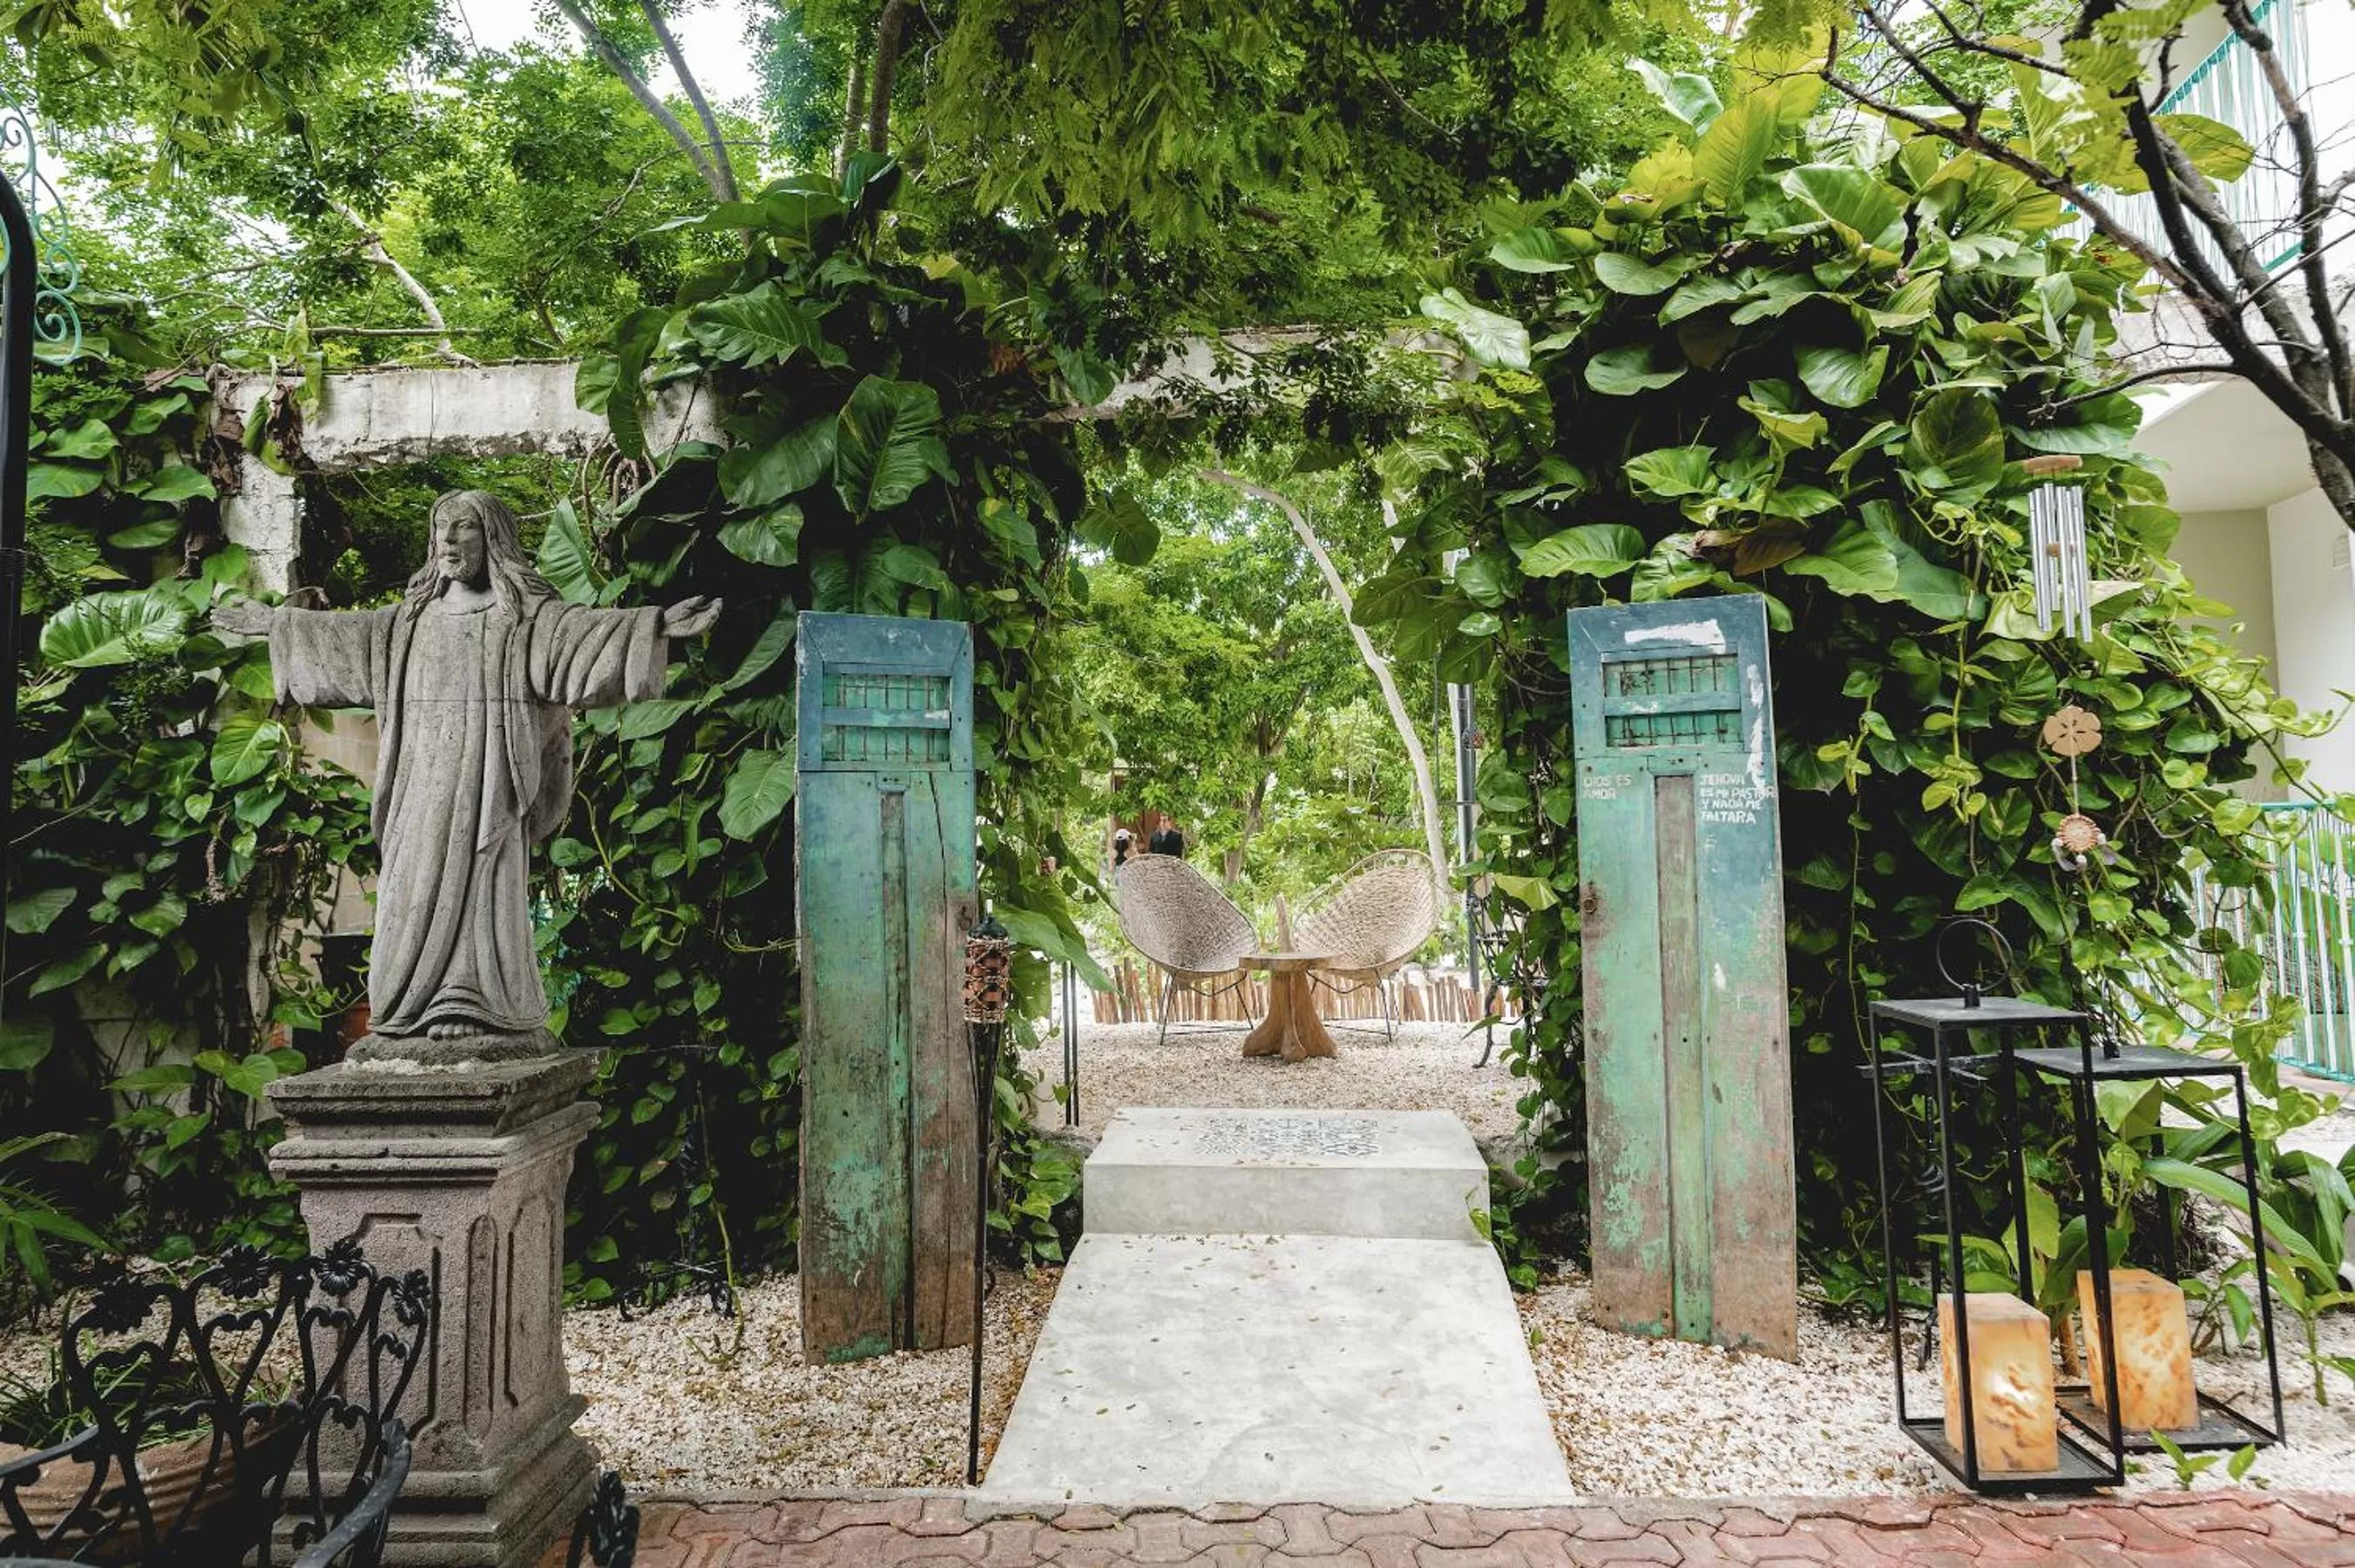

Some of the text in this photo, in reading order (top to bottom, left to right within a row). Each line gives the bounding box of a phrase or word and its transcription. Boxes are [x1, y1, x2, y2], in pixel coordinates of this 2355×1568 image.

[1583, 774, 1632, 787] DIOS ES
[1700, 773, 1745, 785] JEHOVA
[1582, 787, 1618, 800] AMOR
[1700, 787, 1715, 797] ES
[1702, 800, 1762, 811] Y NADA ME
[1701, 811, 1756, 824] FALTARA
